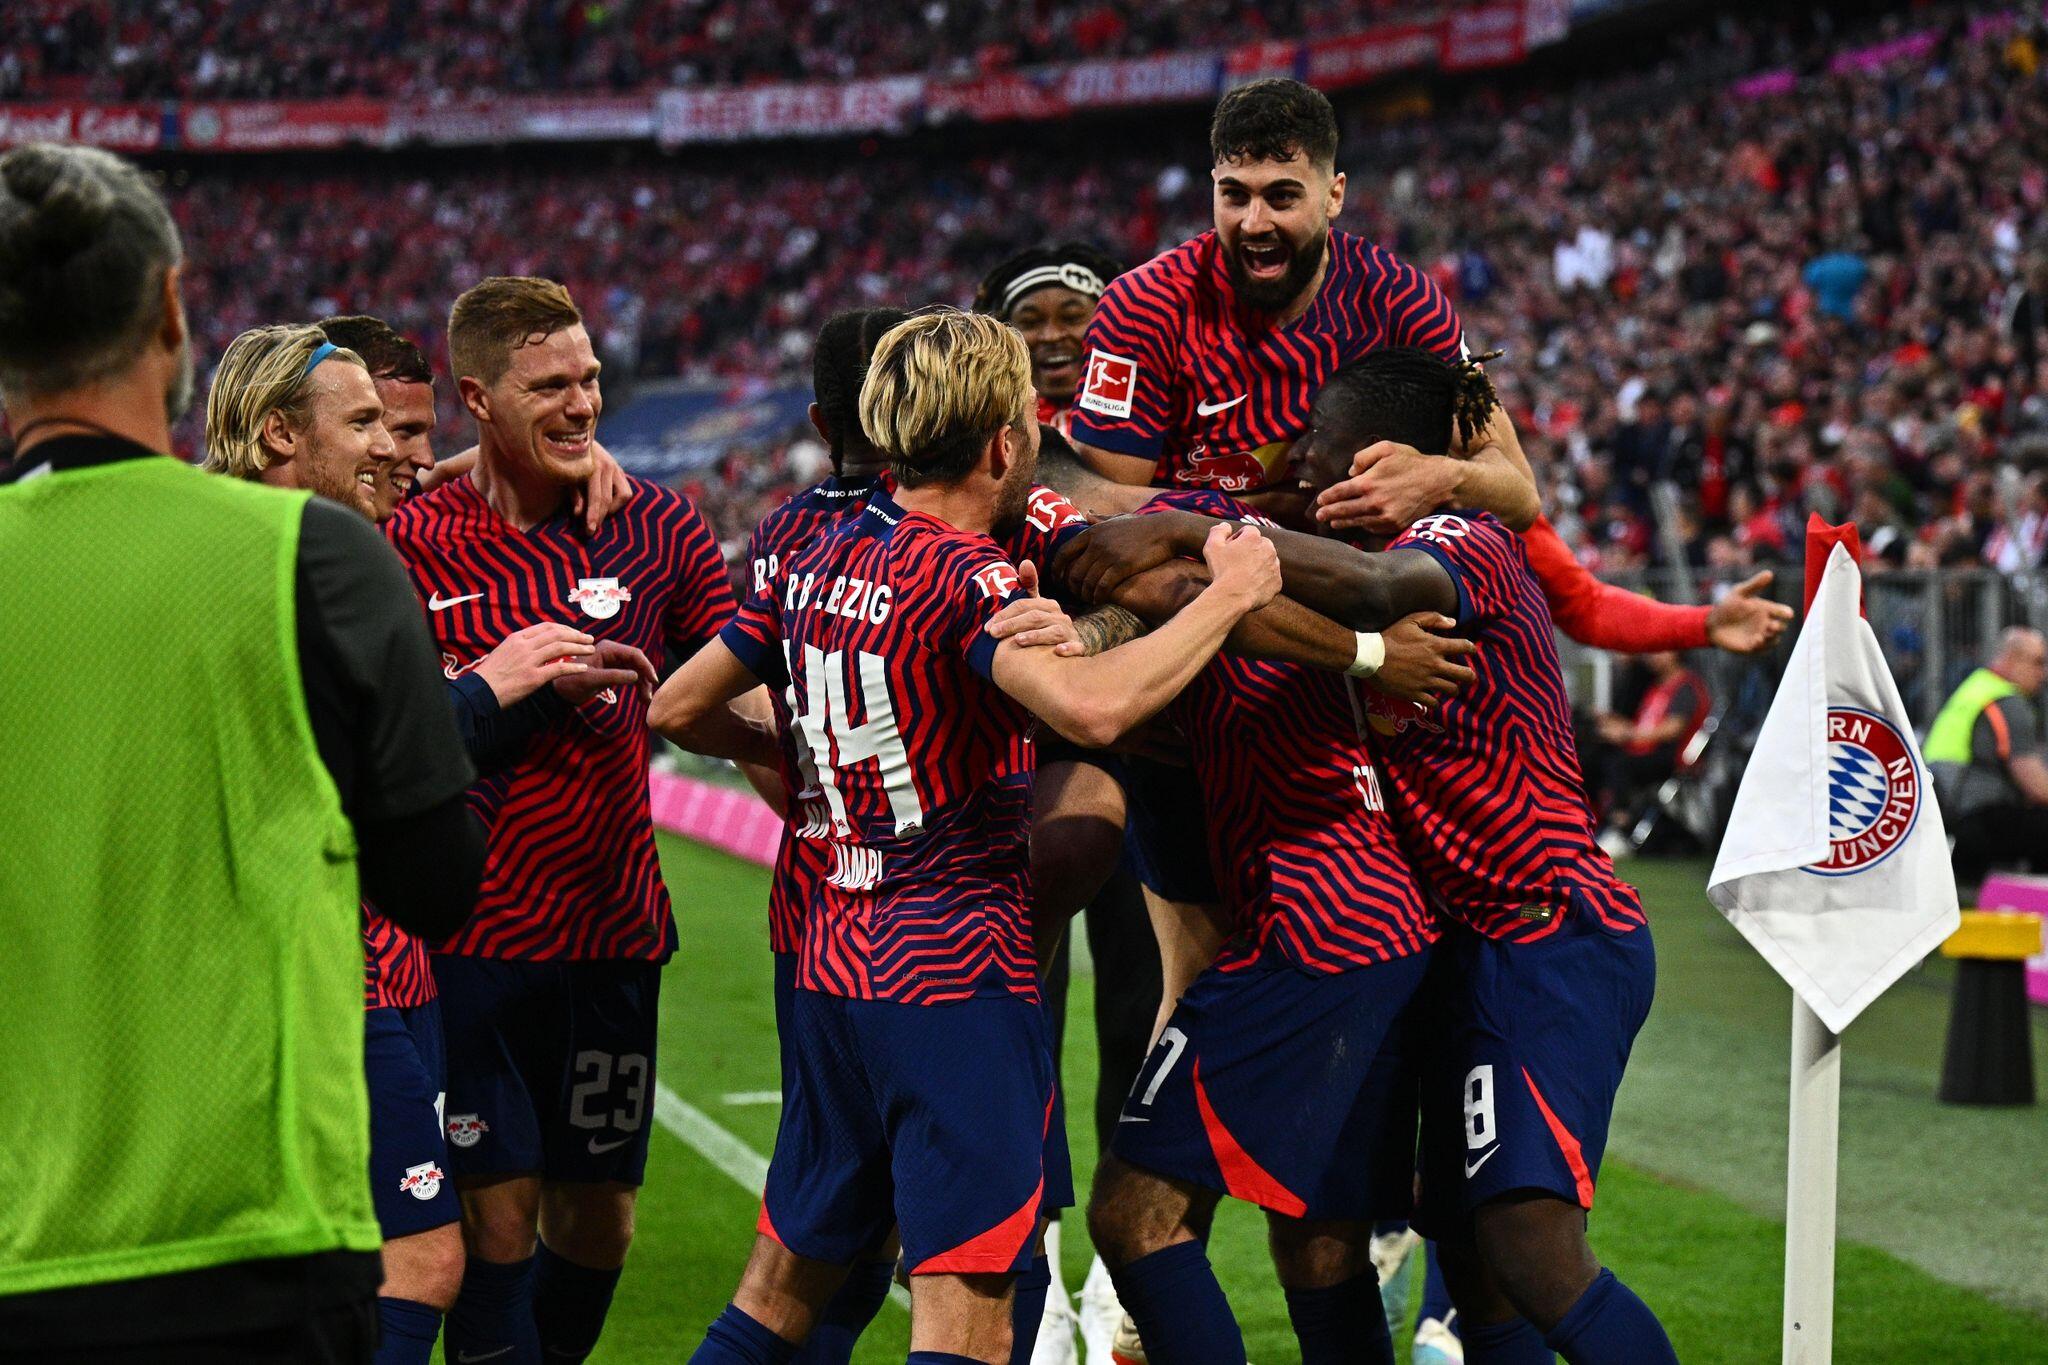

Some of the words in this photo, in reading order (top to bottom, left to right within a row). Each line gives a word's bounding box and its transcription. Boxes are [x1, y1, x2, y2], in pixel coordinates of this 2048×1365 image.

[784, 572, 814, 611] RB
[798, 642, 926, 840] 14
[570, 1050, 648, 1132] 23
[1127, 1026, 1189, 1106] 7
[1464, 1064, 1497, 1150] 8
